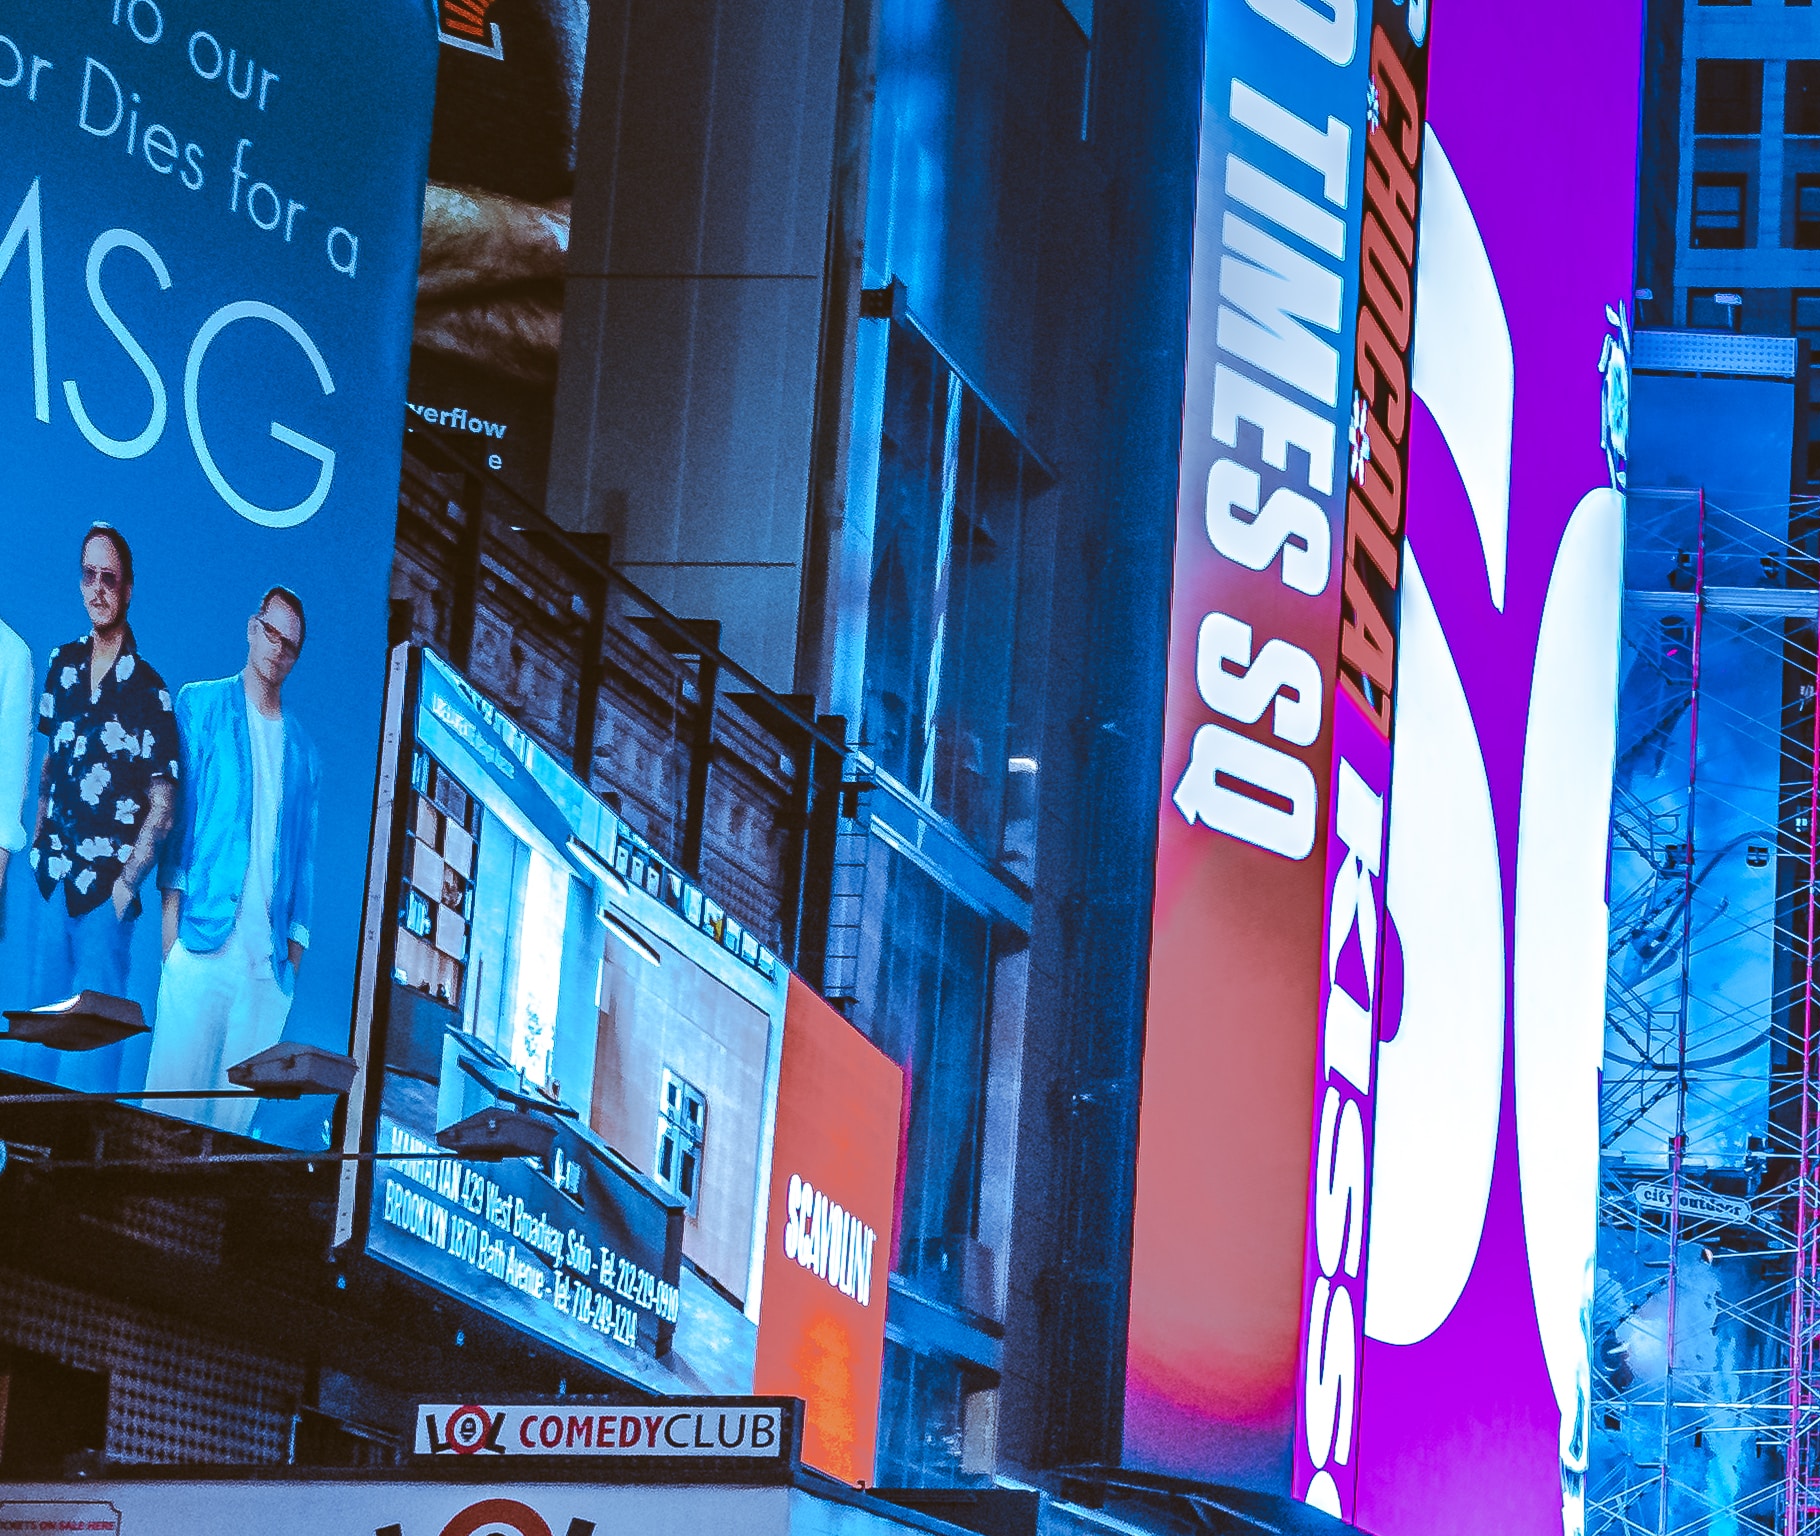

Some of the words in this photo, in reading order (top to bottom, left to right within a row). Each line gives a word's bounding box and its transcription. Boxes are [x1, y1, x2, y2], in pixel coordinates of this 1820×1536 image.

[188, 31, 280, 111] our
[79, 57, 204, 191] Dies
[230, 138, 306, 242] for
[327, 226, 359, 279] a
[1205, 77, 1353, 597] TIMES
[1173, 610, 1324, 861] SQ
[383, 1178, 449, 1249] BROOKLYN
[486, 1180, 513, 1232] West
[567, 1229, 592, 1276] Soho
[785, 1174, 876, 1306] SCAVOLINI
[1643, 1187, 1673, 1211] city
[426, 1404, 506, 1454] LOL
